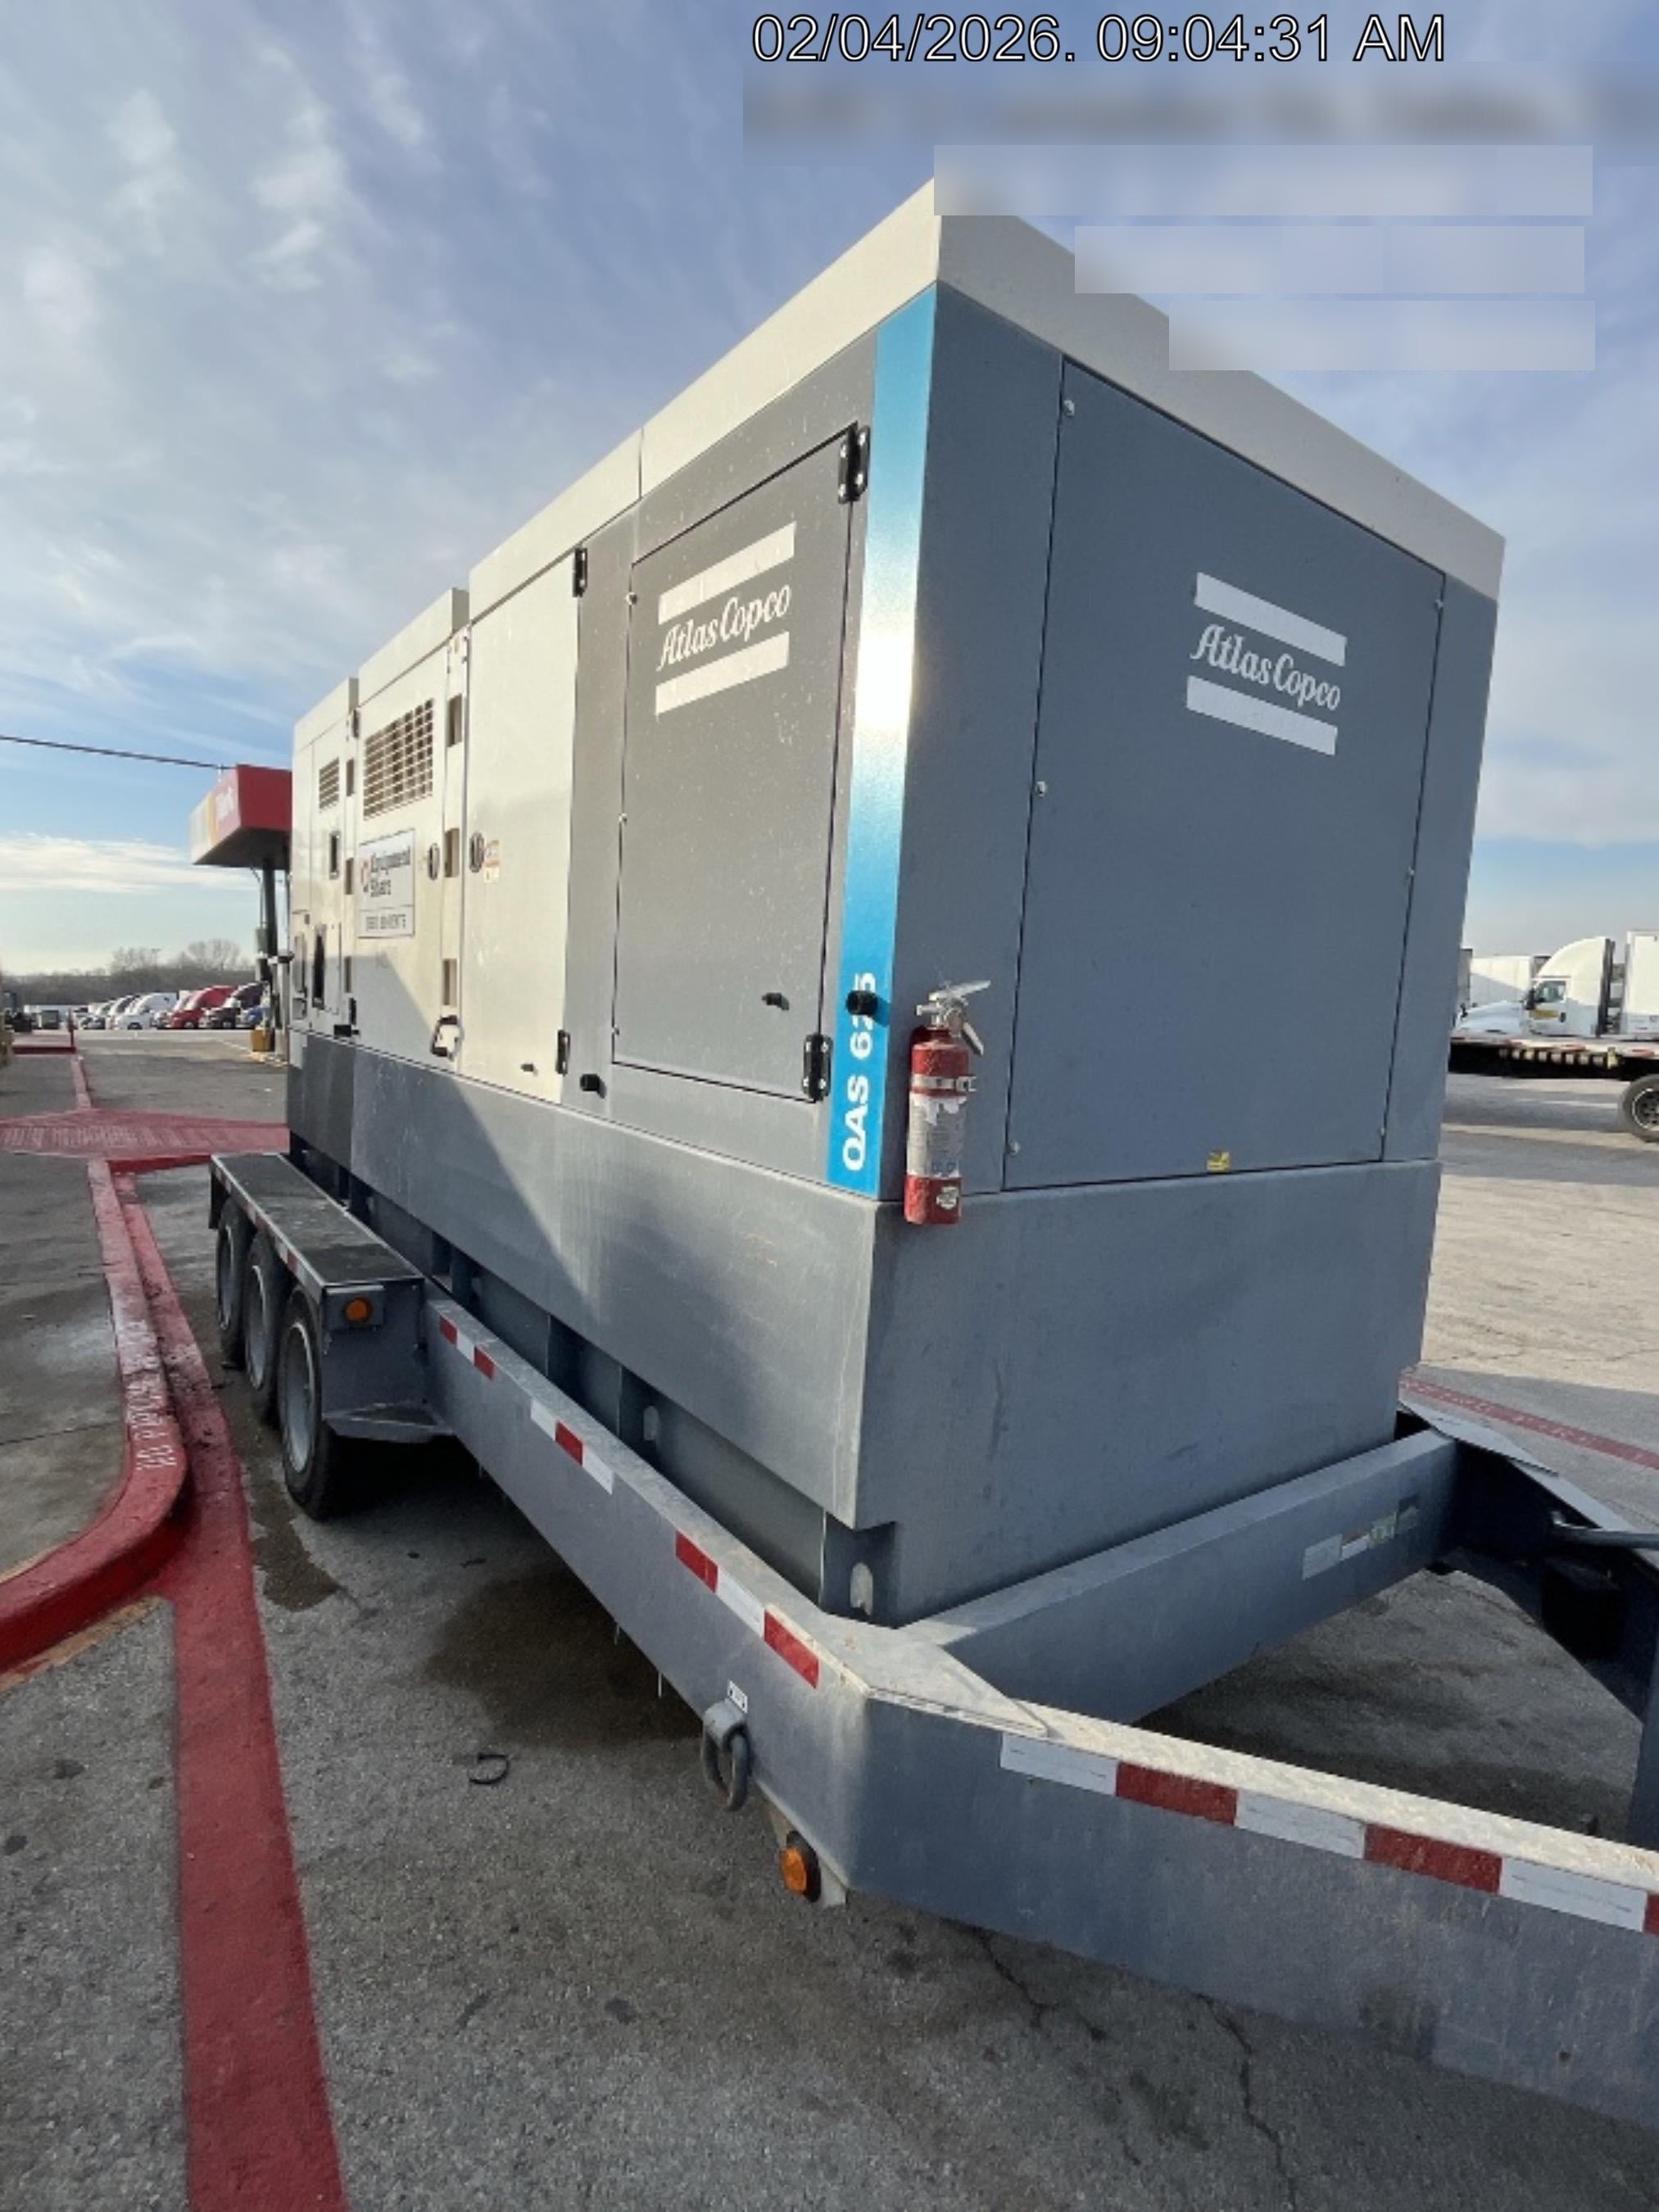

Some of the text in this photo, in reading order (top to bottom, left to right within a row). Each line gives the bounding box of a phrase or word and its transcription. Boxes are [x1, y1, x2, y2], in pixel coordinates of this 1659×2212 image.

[656, 584, 791, 672] Atlas Copco
[1190, 623, 1341, 711] Atlas Copco
